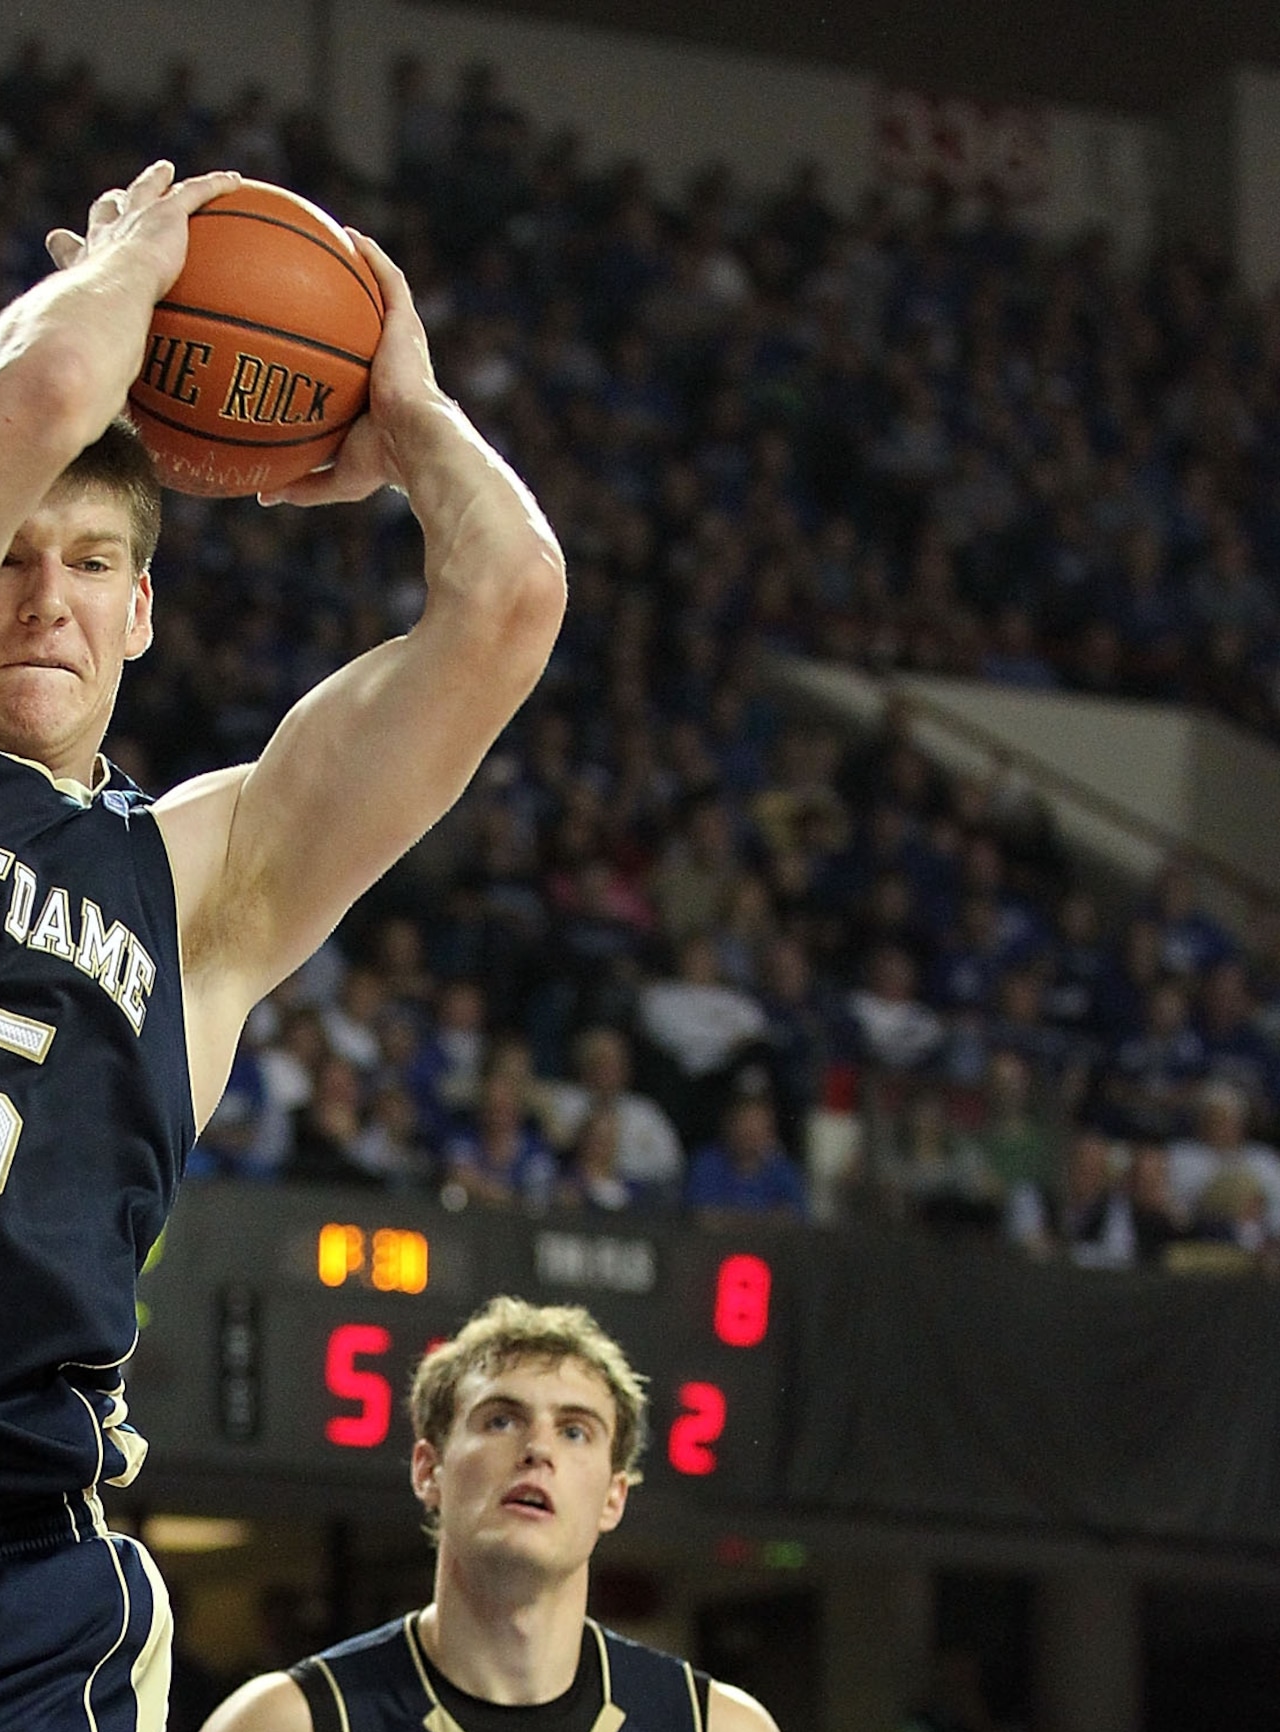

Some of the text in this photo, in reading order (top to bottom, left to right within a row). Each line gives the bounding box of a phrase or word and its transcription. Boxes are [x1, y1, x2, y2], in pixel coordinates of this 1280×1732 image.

[141, 334, 335, 427] HE ROCK
[4, 860, 157, 1039] DAME
[668, 1381, 727, 1476] 2
